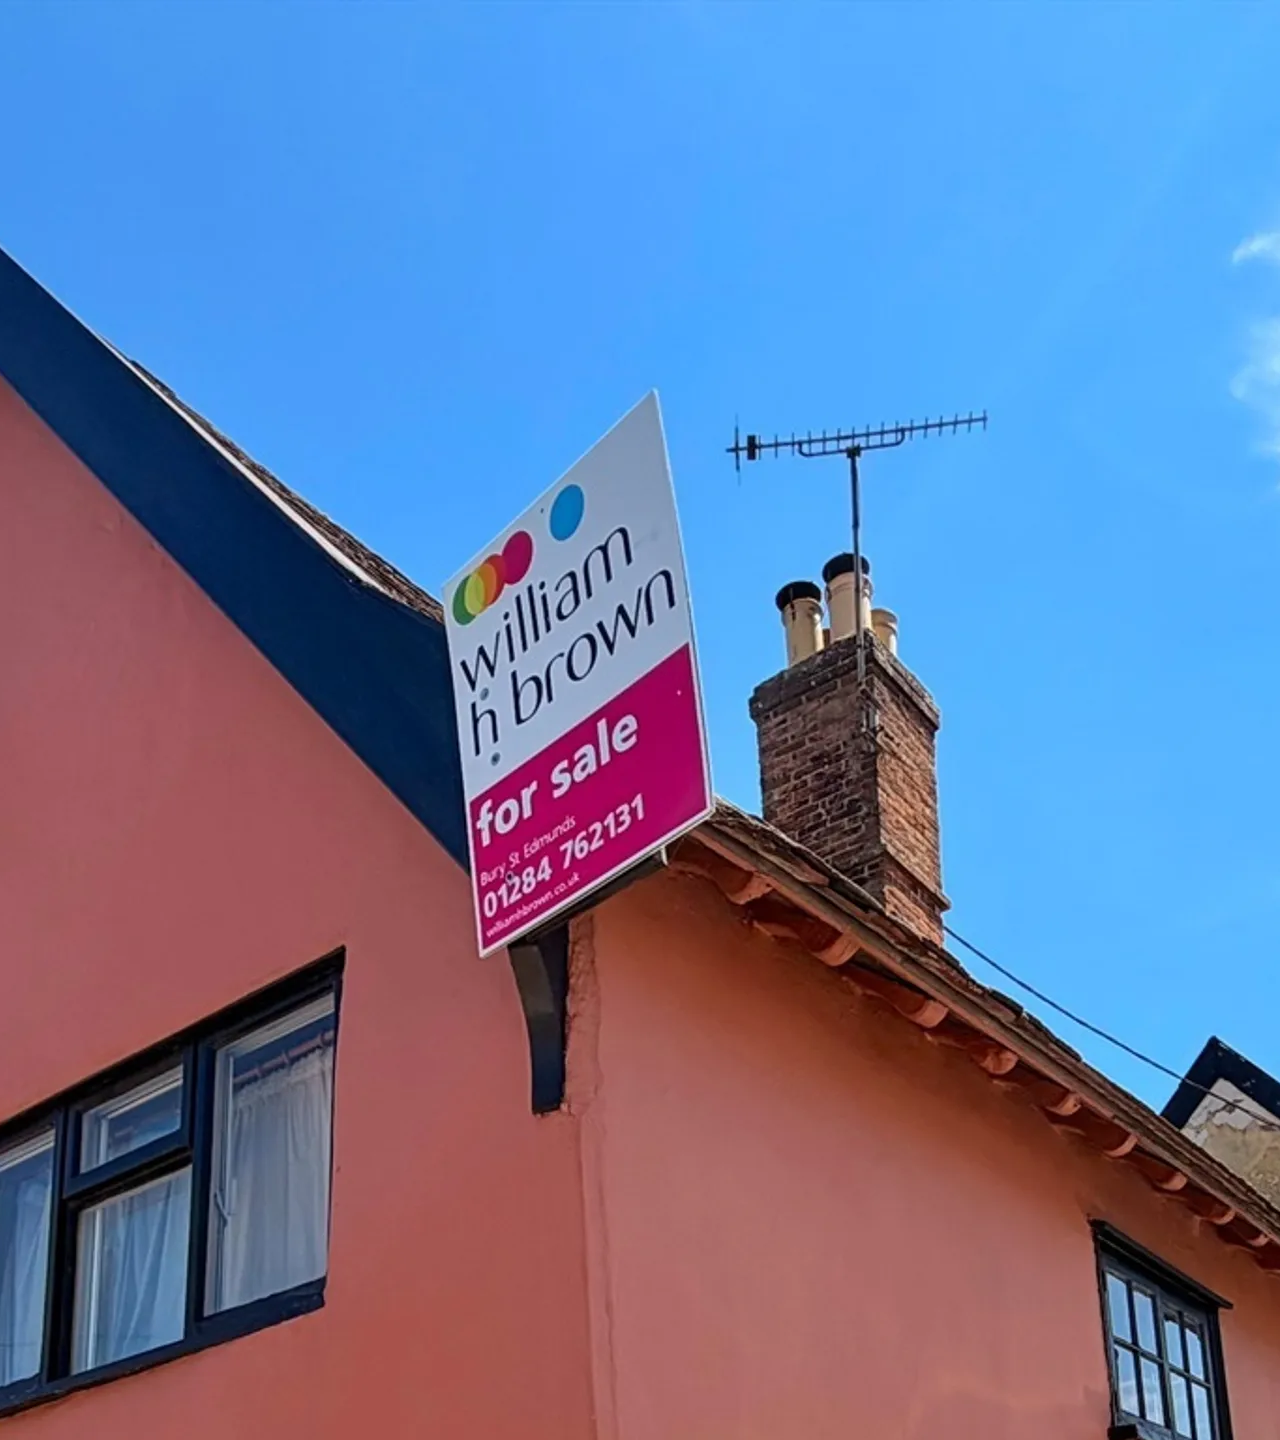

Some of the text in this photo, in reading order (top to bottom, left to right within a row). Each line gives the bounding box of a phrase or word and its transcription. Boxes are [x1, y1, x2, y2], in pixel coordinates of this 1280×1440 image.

[460, 526, 633, 692] william
[470, 568, 676, 756] h brown
[476, 713, 639, 847] for sale
[480, 862, 506, 887] Bury
[523, 814, 576, 859] Edmunds
[483, 793, 645, 918] 01284 762131
